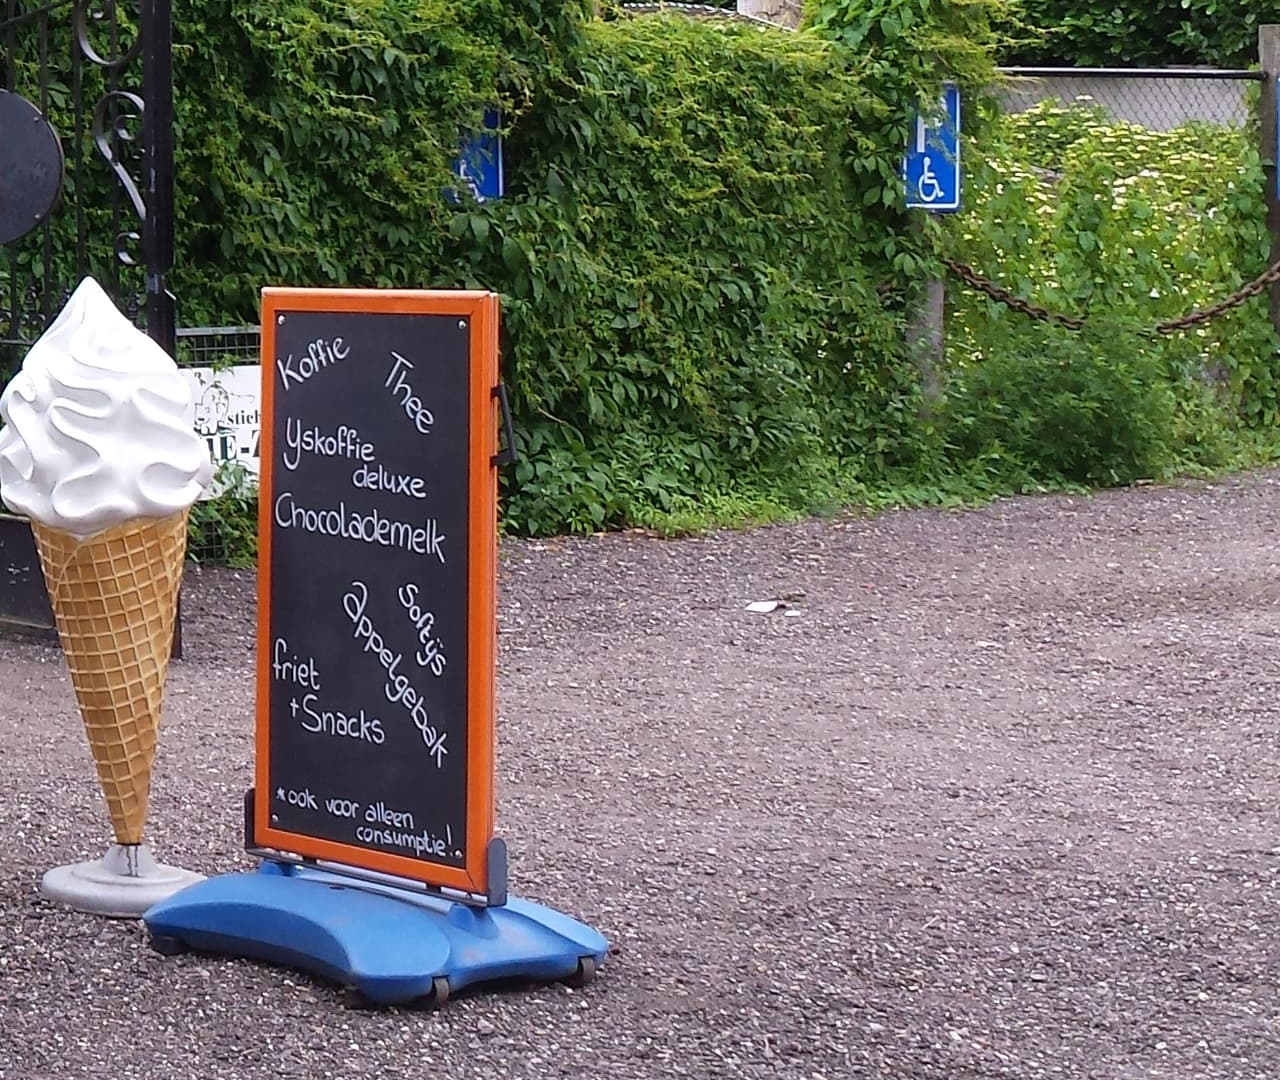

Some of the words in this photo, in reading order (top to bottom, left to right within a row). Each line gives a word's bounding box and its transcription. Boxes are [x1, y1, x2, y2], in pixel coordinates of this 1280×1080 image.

[277, 337, 349, 390] Koffie
[384, 352, 434, 434] Thee
[352, 464, 427, 498] deluxe
[275, 492, 446, 564] Chocolademelk
[325, 798, 360, 819] voor
[365, 801, 415, 830] alleen
[356, 823, 453, 857] consumptie!
